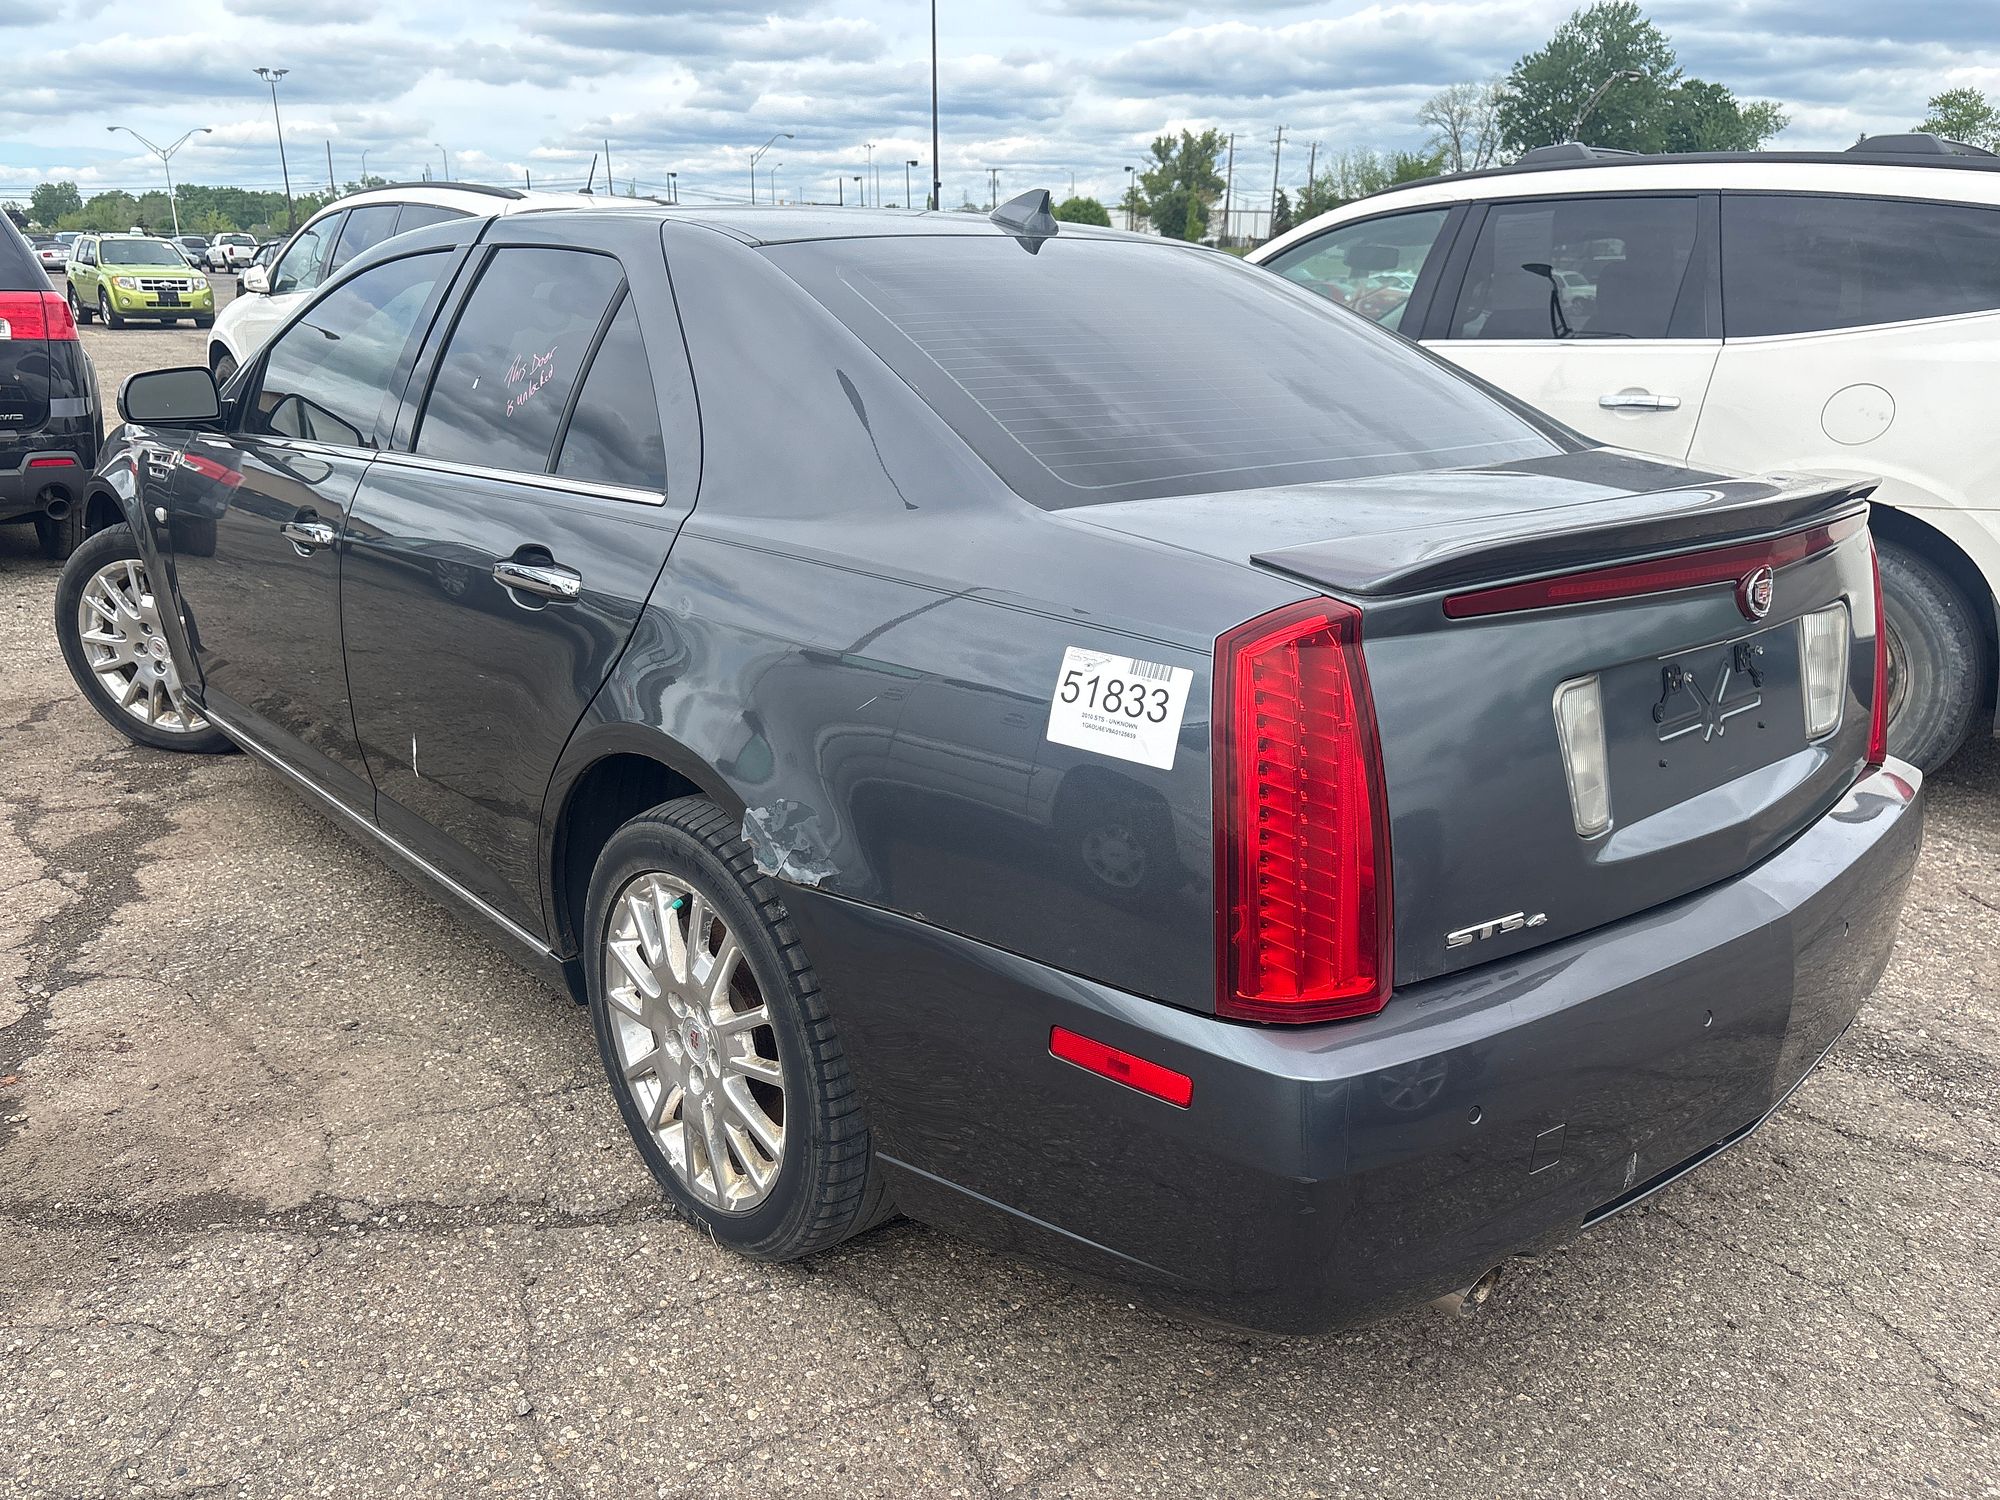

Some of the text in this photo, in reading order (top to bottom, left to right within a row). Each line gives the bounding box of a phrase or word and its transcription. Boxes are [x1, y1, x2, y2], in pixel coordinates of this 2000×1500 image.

[1060, 669, 1170, 723] 51833
[1081, 711, 1094, 720] 2010
[1094, 714, 1105, 723] STS
[1108, 717, 1139, 730] UNKNOWN
